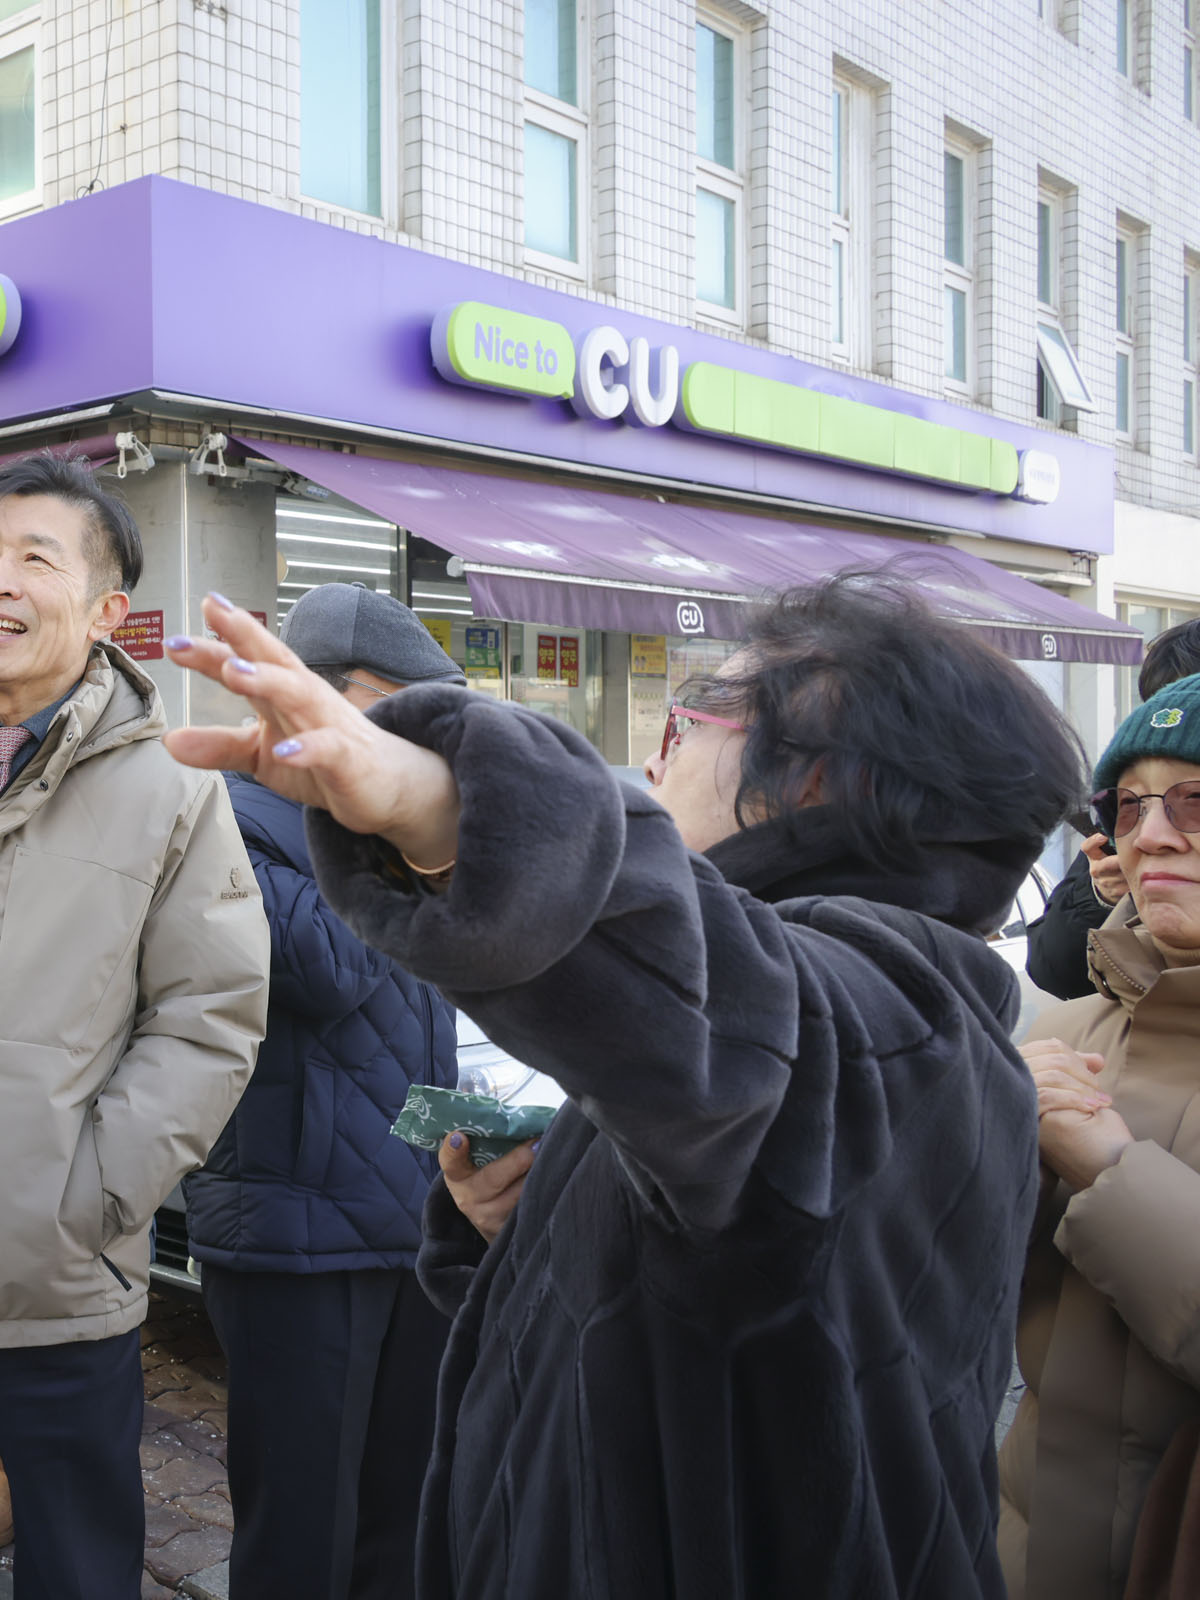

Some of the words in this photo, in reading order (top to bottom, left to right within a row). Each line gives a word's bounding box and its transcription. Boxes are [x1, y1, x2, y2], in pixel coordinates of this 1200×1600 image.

[474, 322, 529, 369] Nice
[535, 340, 558, 375] to
[580, 326, 679, 427] CU
[681, 609, 698, 626] CU
